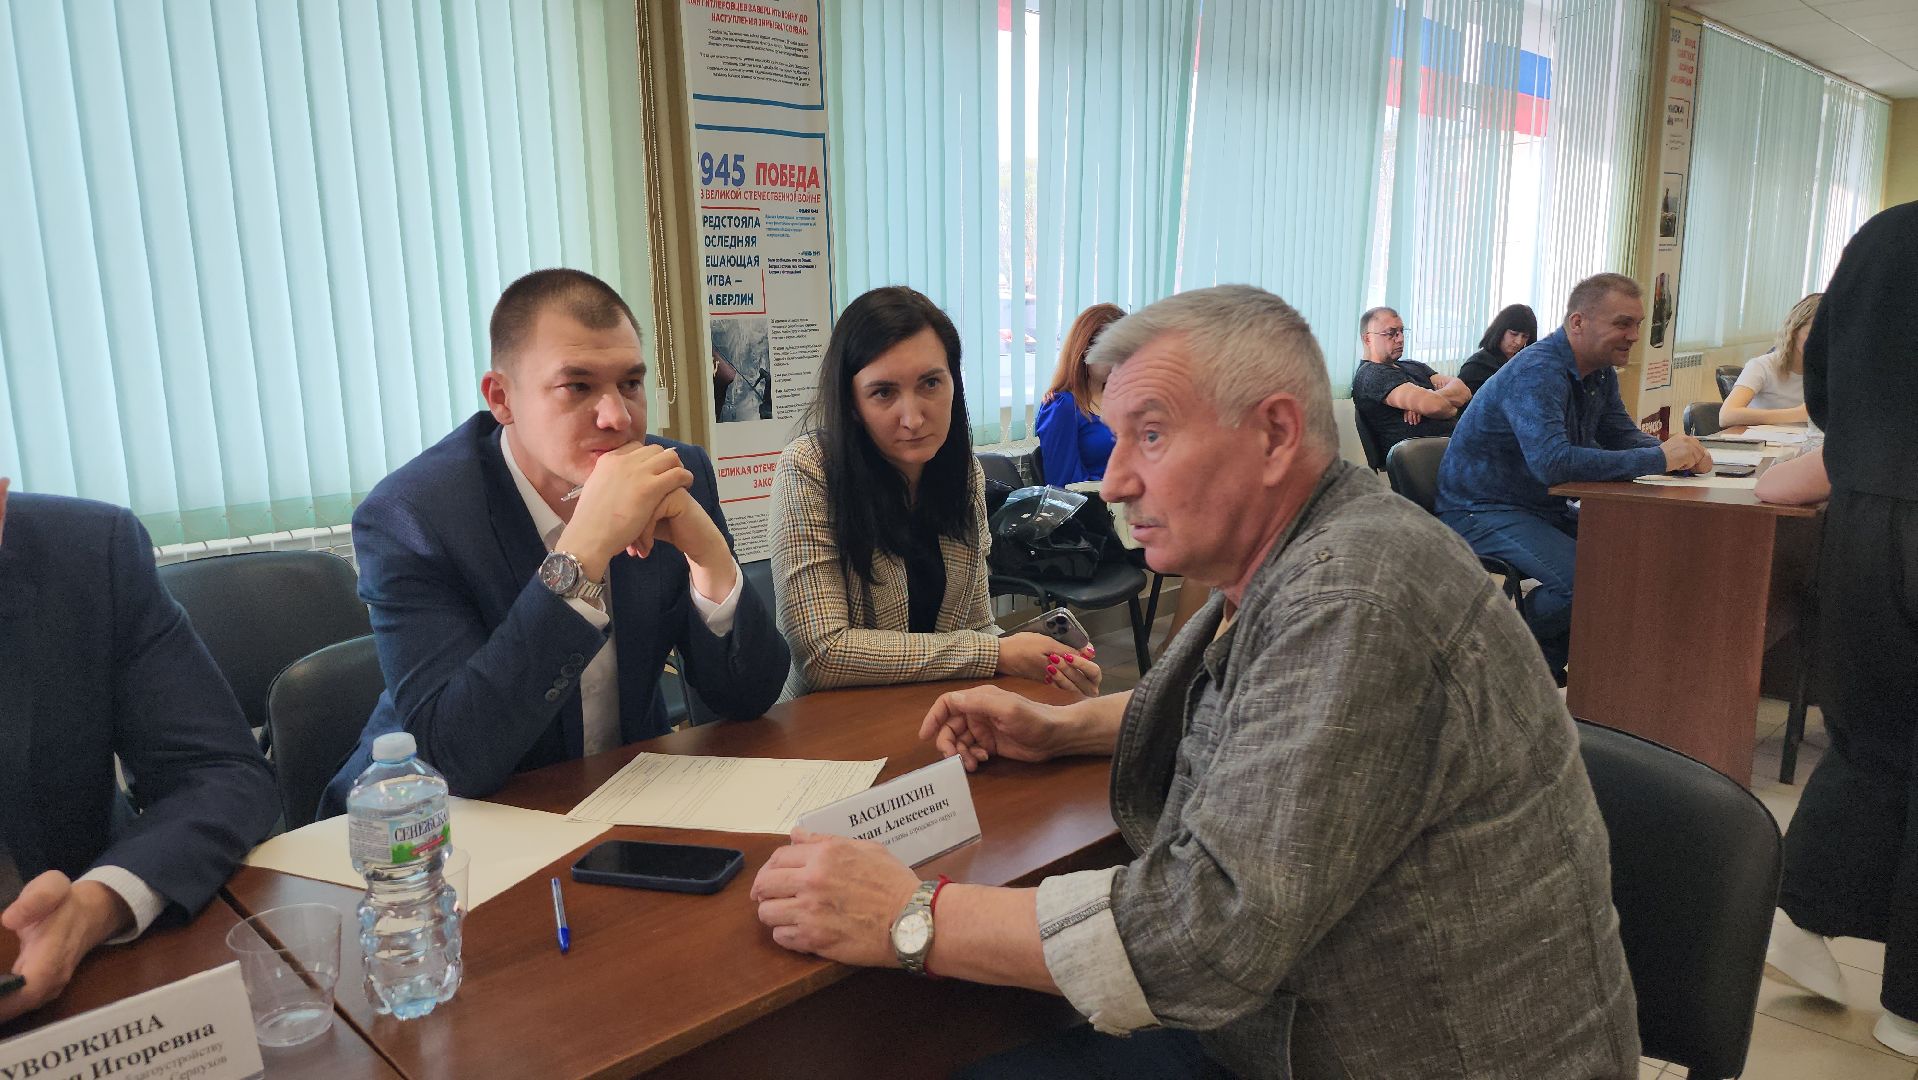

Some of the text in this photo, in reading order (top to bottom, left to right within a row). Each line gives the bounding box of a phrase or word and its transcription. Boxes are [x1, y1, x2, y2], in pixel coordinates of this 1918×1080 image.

[711, 12, 758, 27] НАСТУПЛЕНИЯ
[798, 14, 808, 23] ДО
[698, 152, 820, 192] 945 ПОБЕДА
[705, 188, 742, 200] ВЕЛИКОЙ
[743, 190, 798, 203] ОТЕЧЕСТВЕННОЙ
[797, 192, 821, 204] ВОЙНЕ
[702, 214, 761, 231] РЕДСТОЯЛА
[704, 234, 757, 250] ОСЛЕДНЯЯ
[705, 254, 760, 270] ЕШАЮЩАЯ
[706, 274, 732, 287] ИТВА
[708, 292, 754, 306] А БЕРЛИН
[718, 462, 777, 478] ЕЛИКАЯ ОТЕЧЕ
[753, 477, 774, 489] ЗАКО
[848, 783, 936, 828] ВАСИЛИХИН
[884, 798, 950, 833] Алексеевич
[0, 1013, 165, 1080] УВОРКИНА
[90, 1022, 216, 1080] Игоревна
